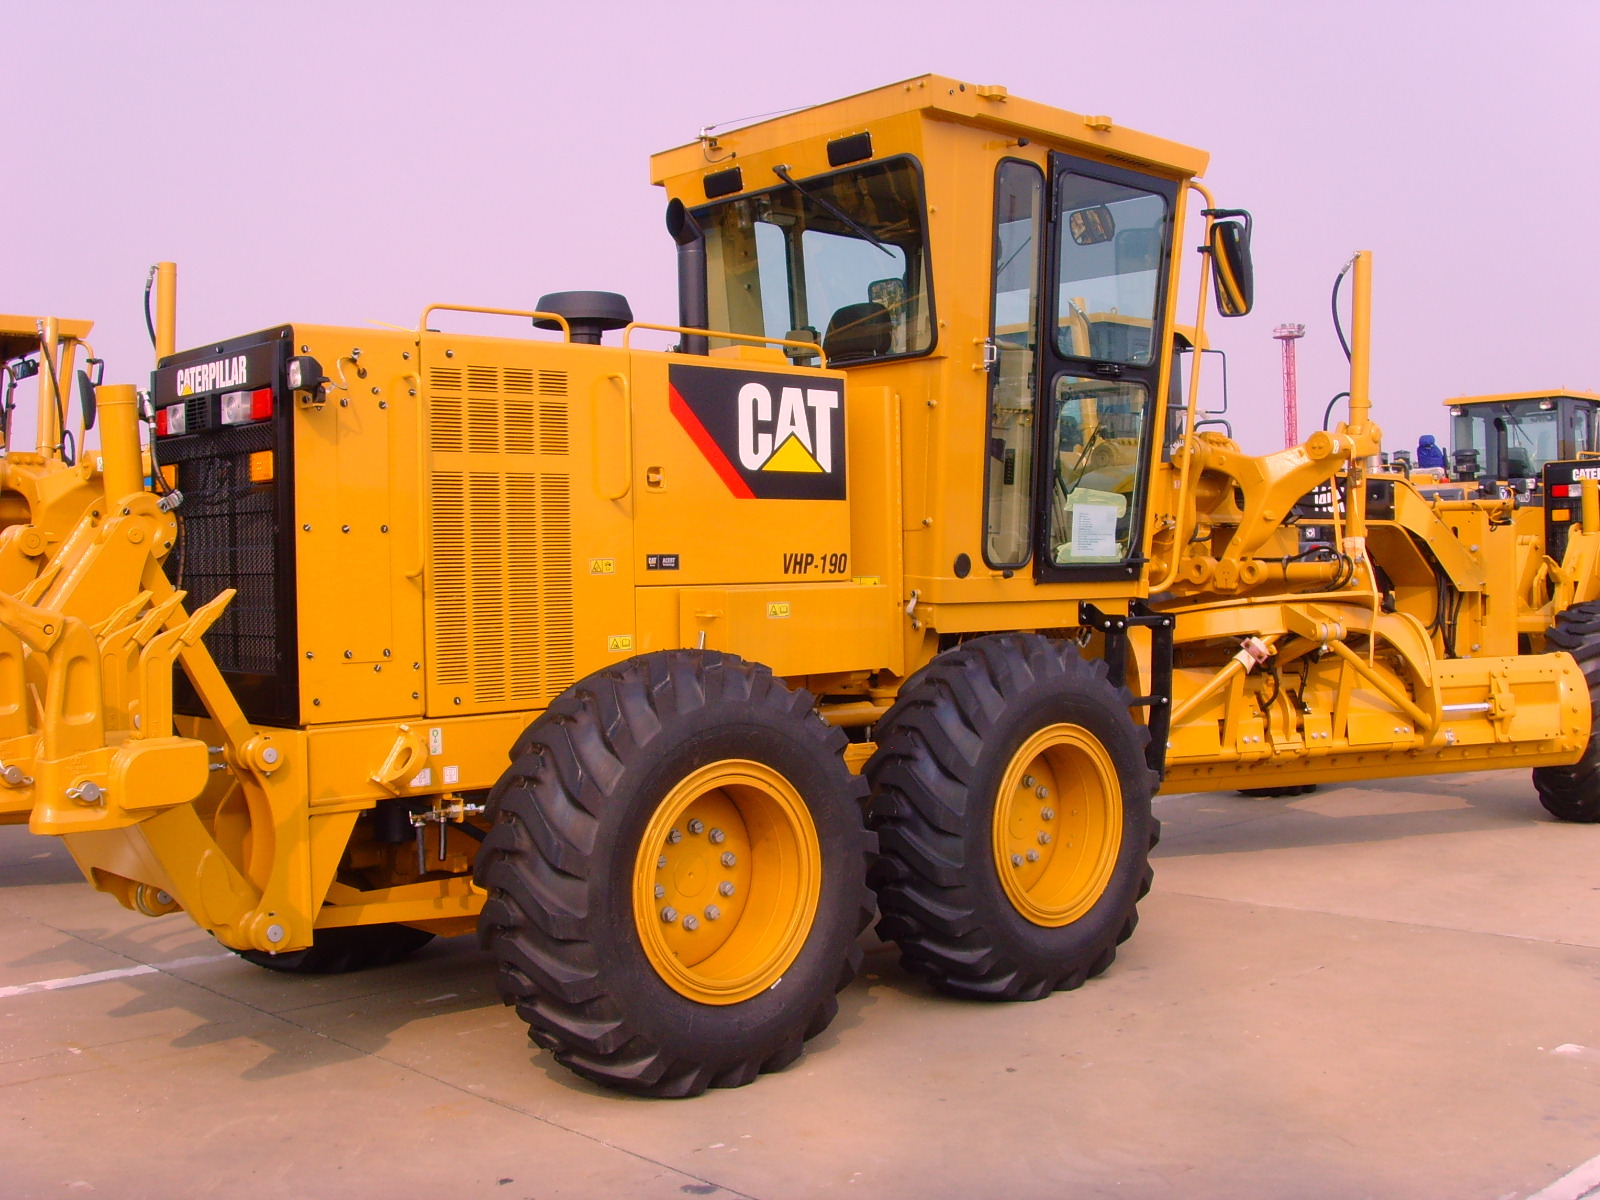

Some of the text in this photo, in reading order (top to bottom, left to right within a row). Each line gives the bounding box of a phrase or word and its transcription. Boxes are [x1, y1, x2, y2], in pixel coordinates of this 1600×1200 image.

[176, 355, 247, 397] CATERPILLAR
[738, 382, 839, 473] CAT
[783, 552, 848, 574] VHP-190
